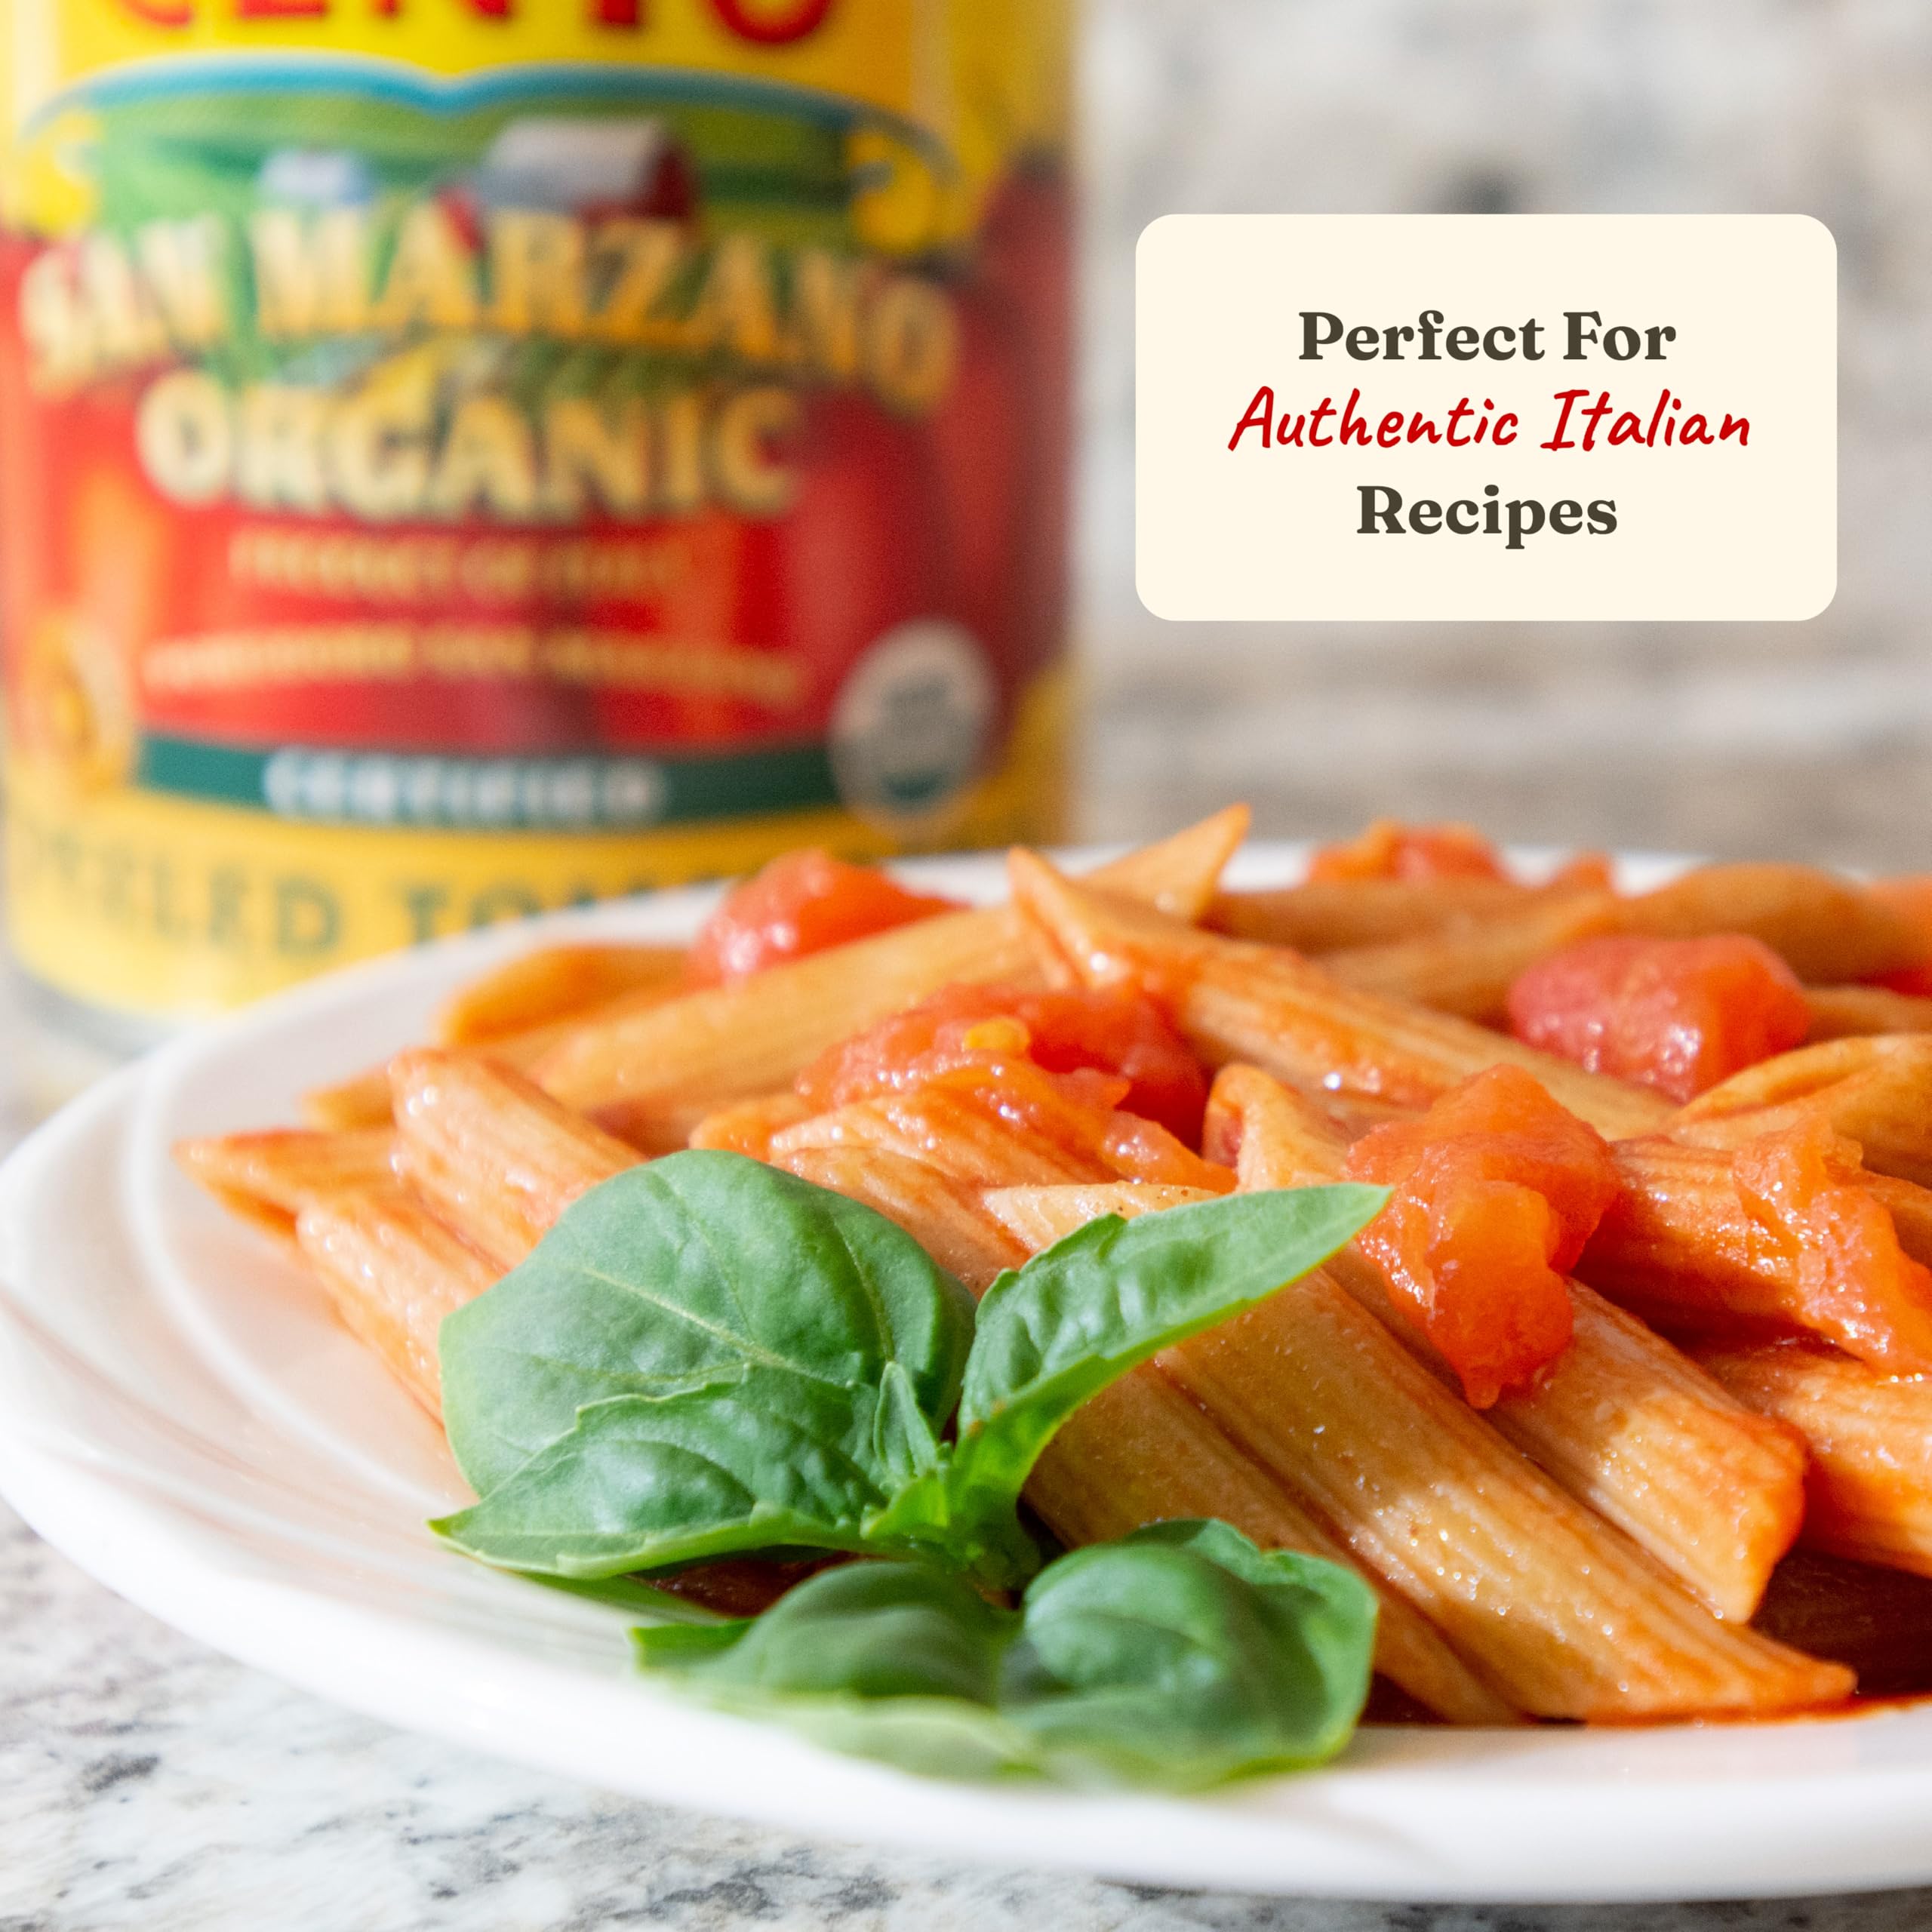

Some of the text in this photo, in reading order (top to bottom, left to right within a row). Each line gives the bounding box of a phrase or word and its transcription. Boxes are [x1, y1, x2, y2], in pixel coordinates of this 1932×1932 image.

[19, 205, 960, 420] SAN MARZANO
[136, 370, 801, 522] ORGANIC
